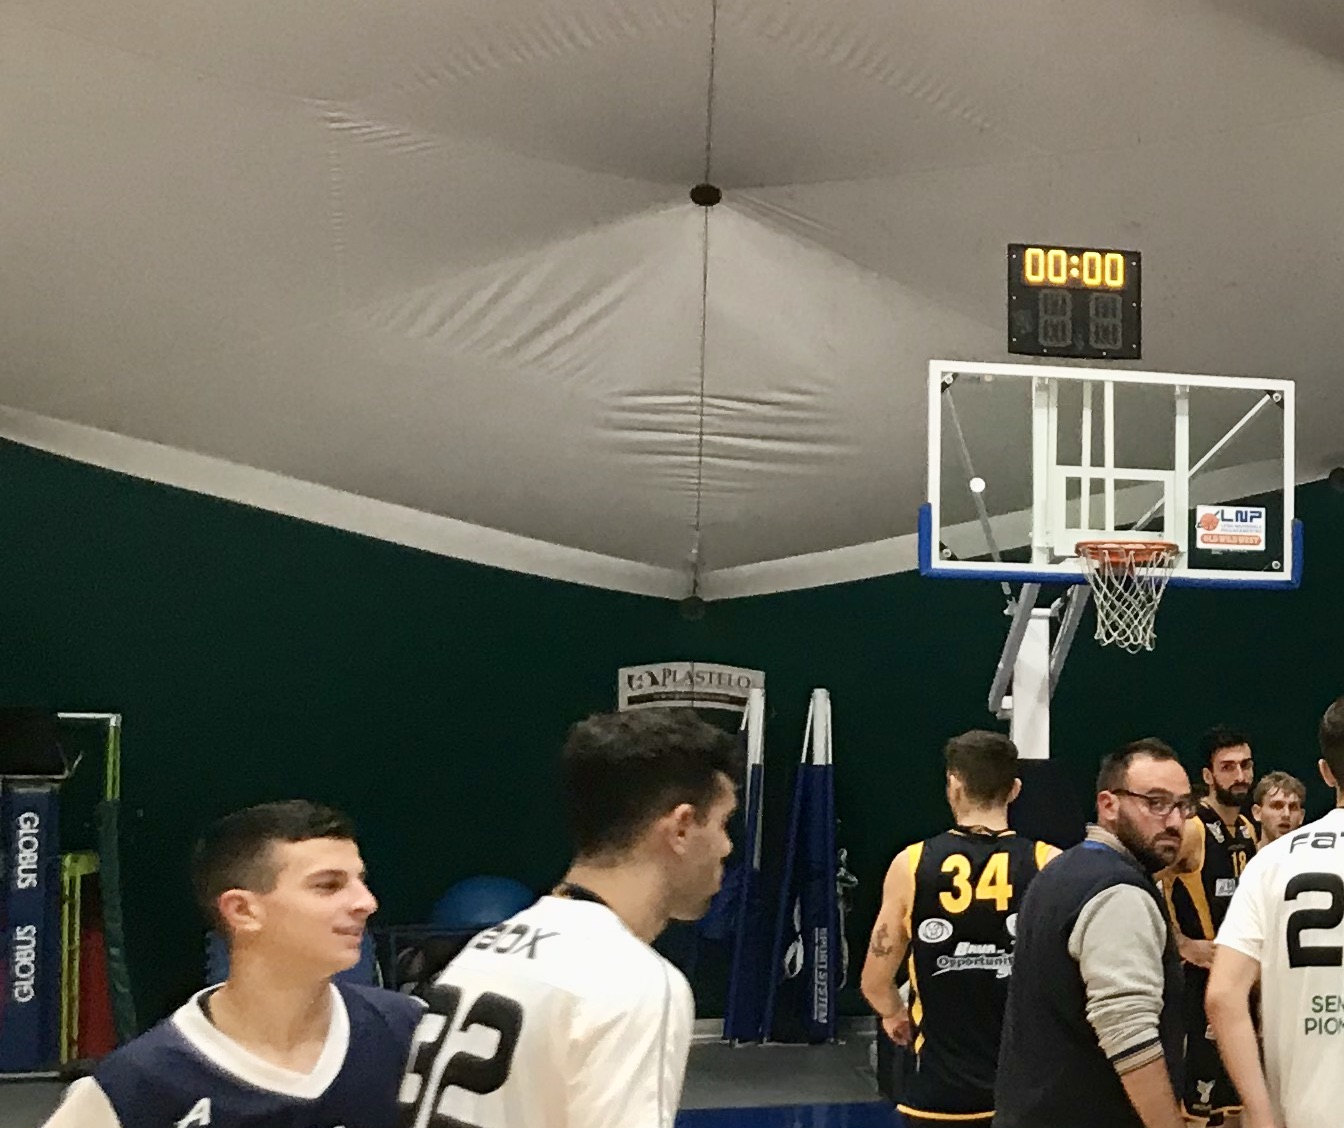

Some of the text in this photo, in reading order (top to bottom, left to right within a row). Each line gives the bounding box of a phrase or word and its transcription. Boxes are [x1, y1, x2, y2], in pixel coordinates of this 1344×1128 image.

[1024, 247, 1126, 289] 00:00
[1221, 509, 1263, 523] LNP
[17, 811, 40, 889] GLOBUS
[938, 851, 1013, 914] 34
[14, 924, 37, 1003] GLOBUS
[936, 953, 1016, 970] Opportunit
